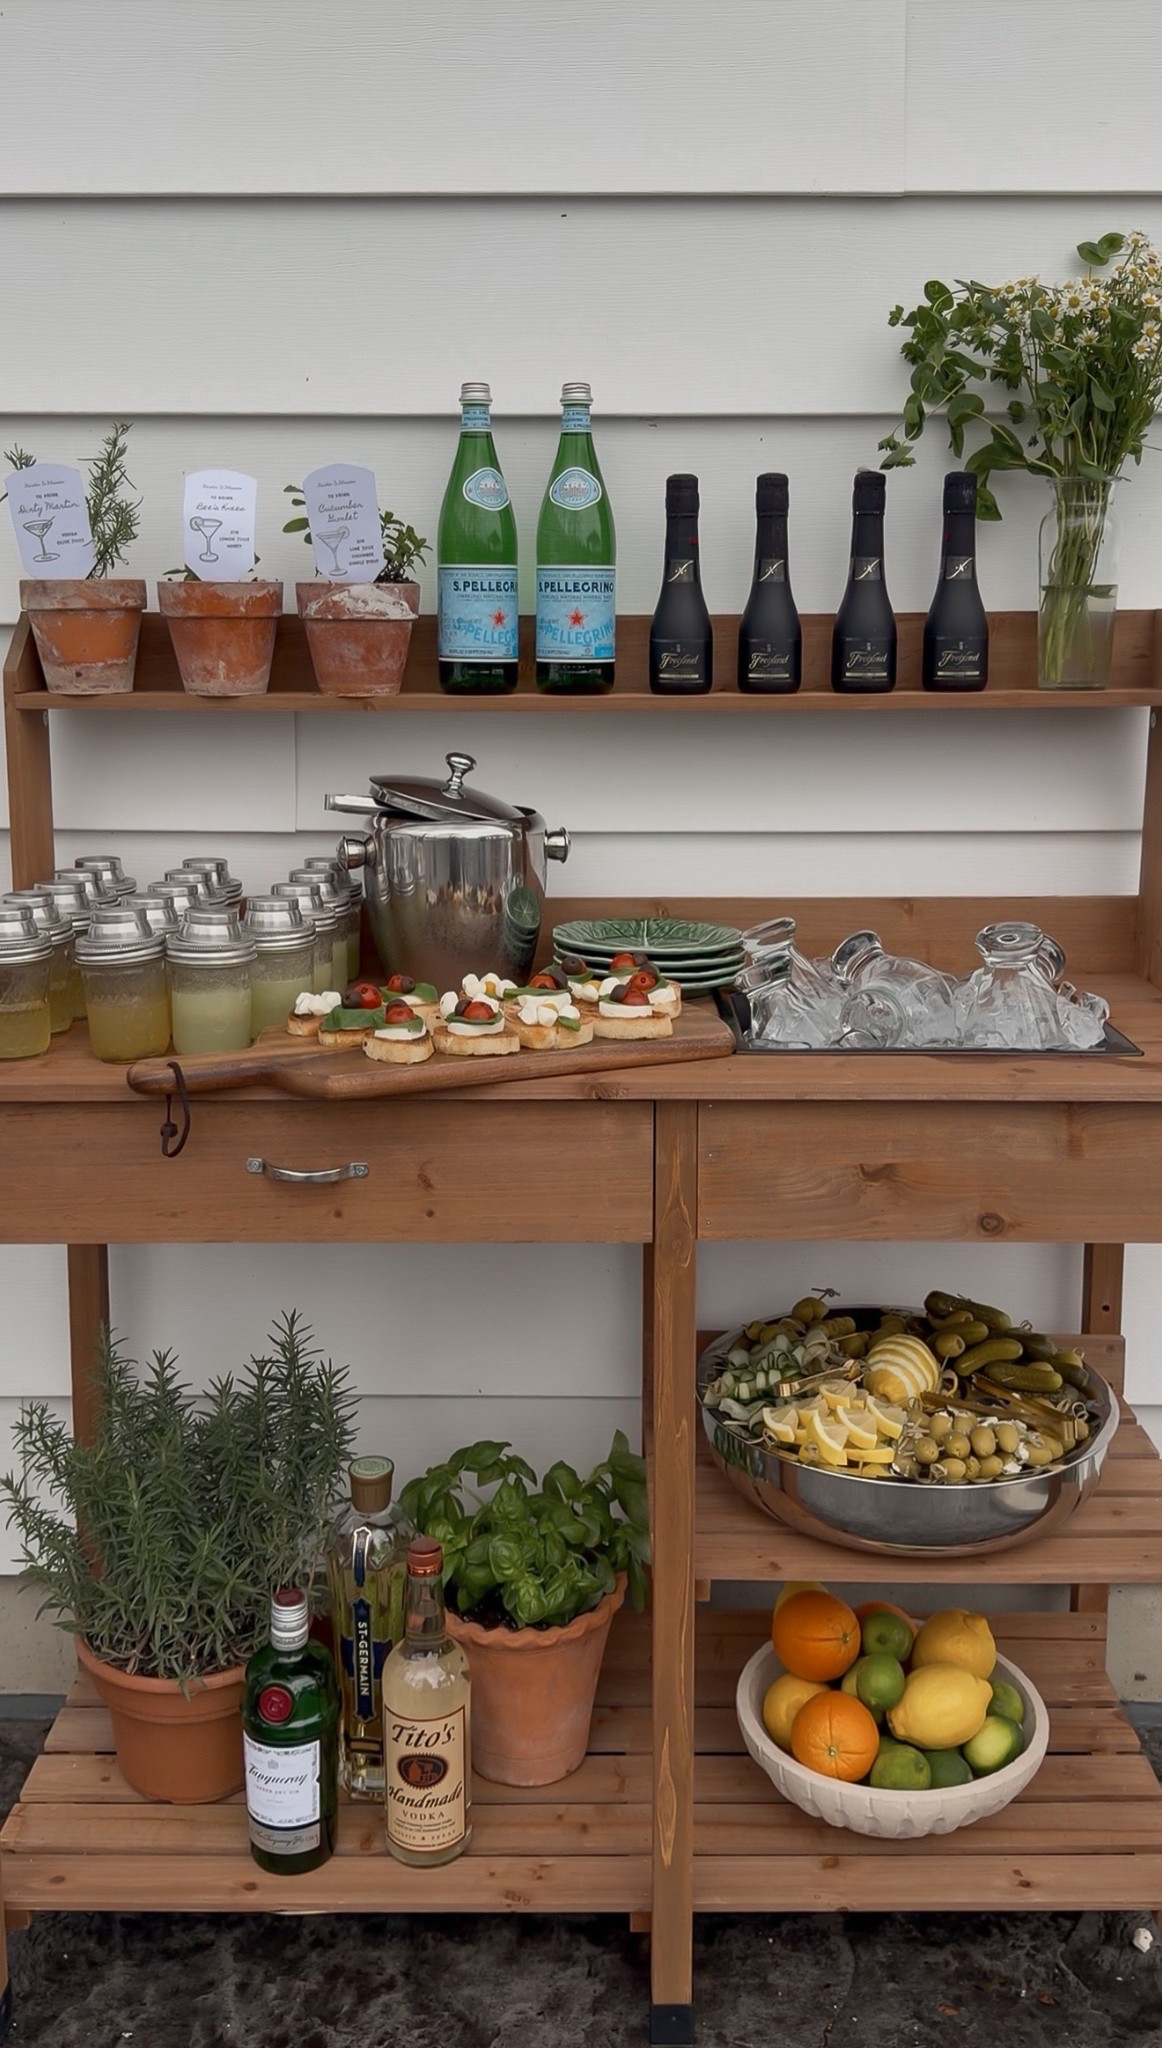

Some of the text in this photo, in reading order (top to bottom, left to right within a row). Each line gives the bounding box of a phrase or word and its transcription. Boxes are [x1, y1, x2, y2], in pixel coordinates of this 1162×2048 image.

[18, 502, 43, 517] Dirty
[221, 503, 246, 512] Knees
[318, 500, 364, 513] Cucumber
[327, 510, 359, 523] Gimlet
[358, 1621, 369, 1696] ST-GERMAIN
[391, 1723, 455, 1748] Tito's
[248, 1763, 308, 1786] Tanqueray
[388, 1780, 463, 1809] Handmade
[402, 1810, 445, 1821] VODKA
